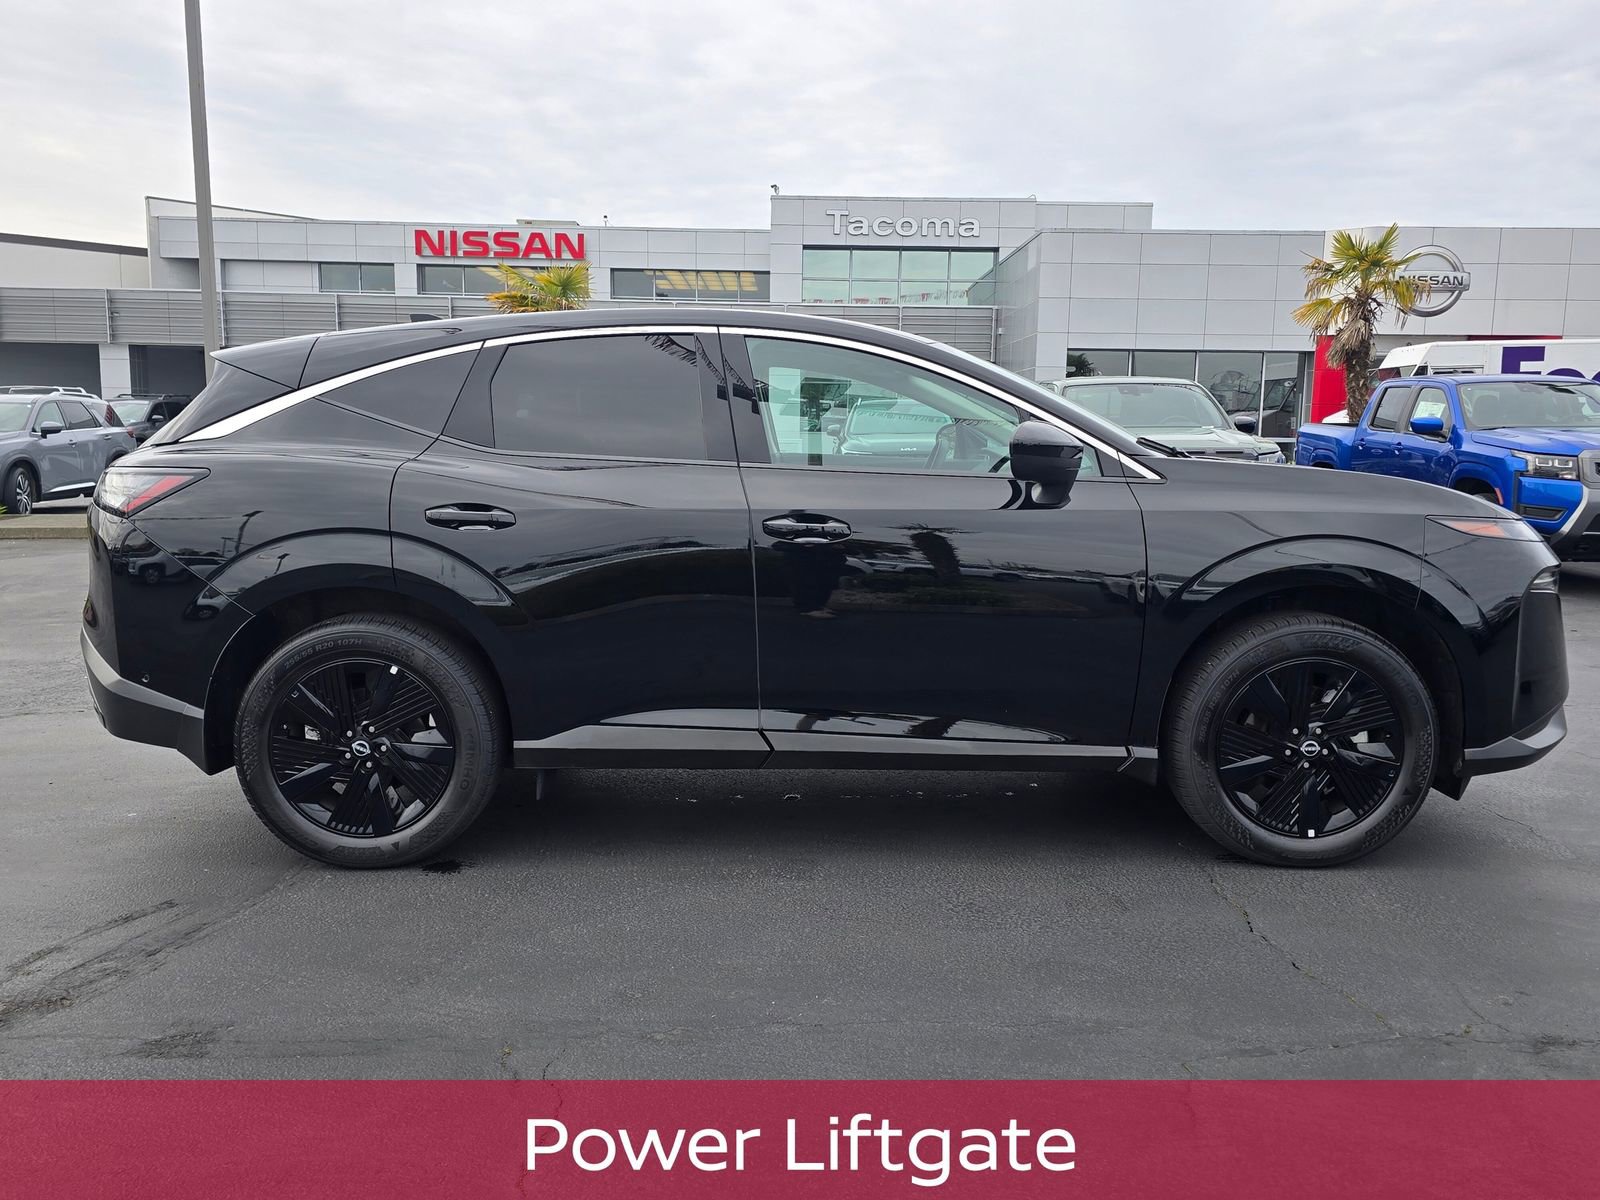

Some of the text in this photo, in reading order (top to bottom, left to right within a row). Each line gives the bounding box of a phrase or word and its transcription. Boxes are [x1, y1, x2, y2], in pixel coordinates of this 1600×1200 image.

[826, 209, 980, 237] Tacoma
[414, 229, 586, 260] NISSAN
[315, 640, 334, 652] R20
[337, 638, 362, 648] 107H
